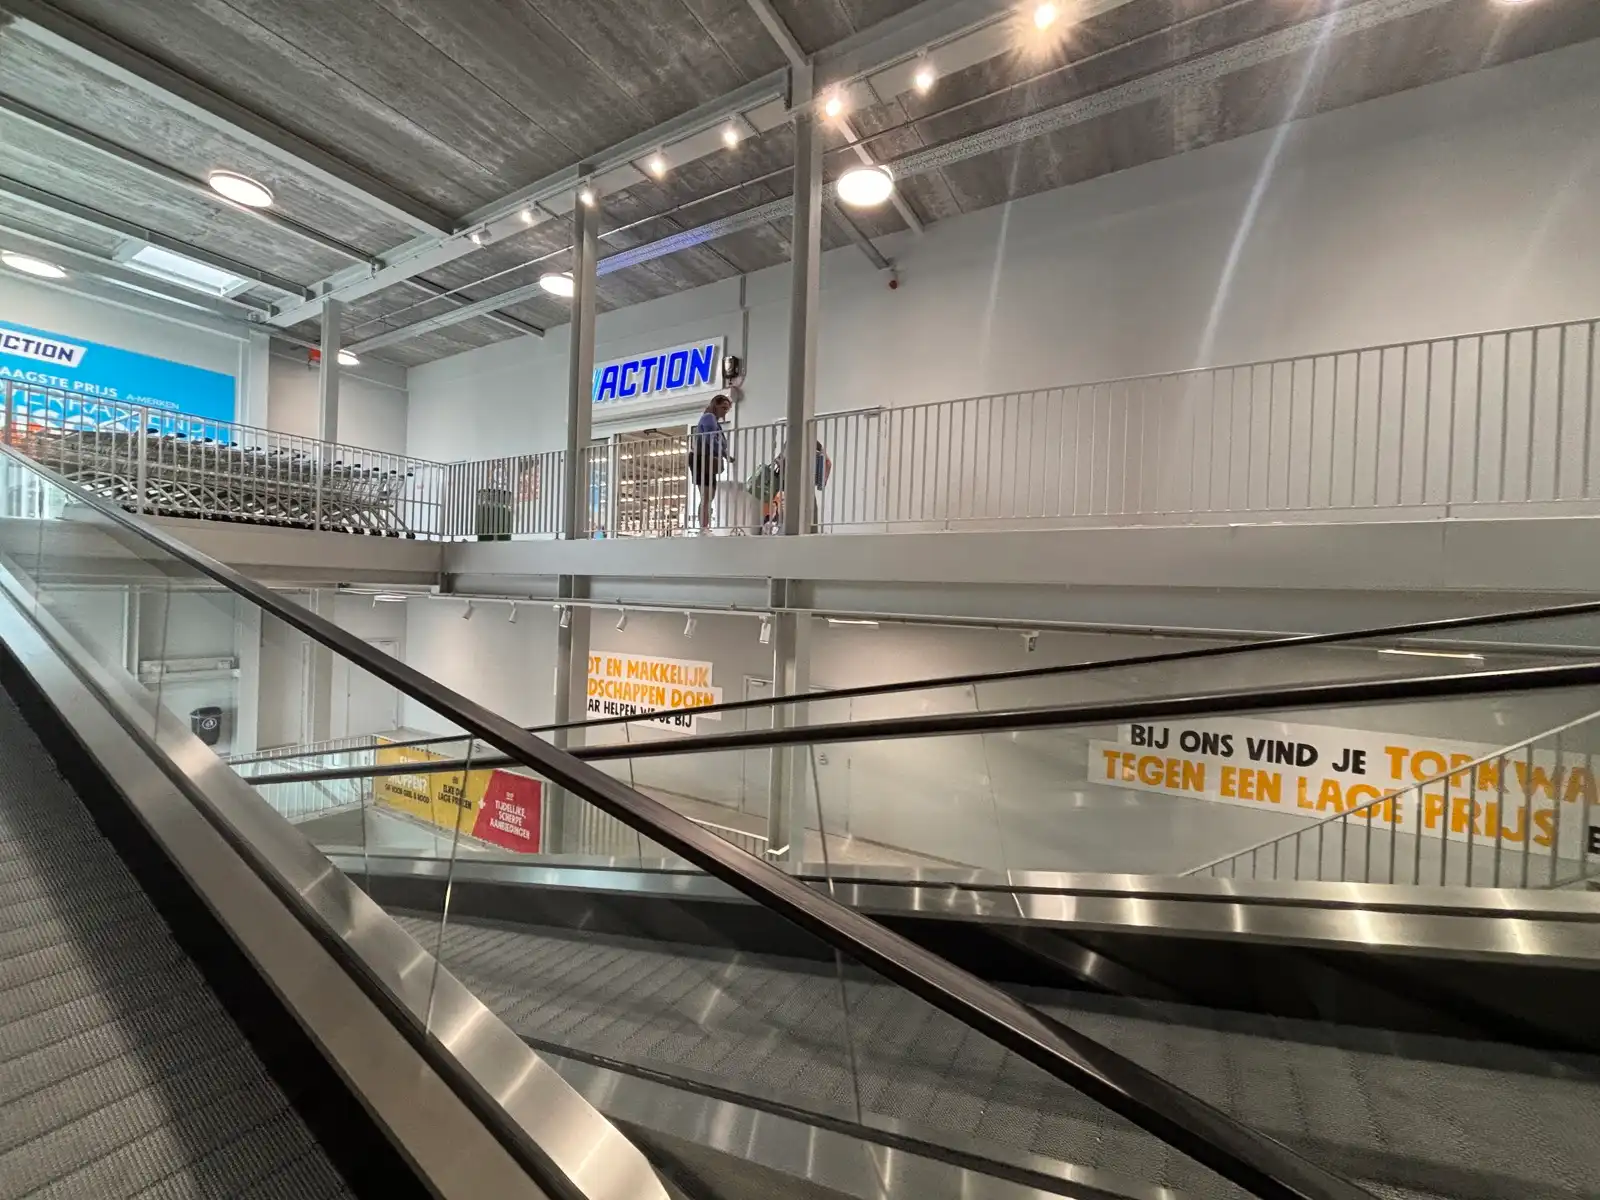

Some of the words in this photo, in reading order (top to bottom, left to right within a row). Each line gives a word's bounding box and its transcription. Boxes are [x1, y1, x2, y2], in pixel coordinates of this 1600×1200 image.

[0, 333, 74, 362] CTION
[597, 344, 714, 401] ACTION
[73, 380, 118, 398] PRIJS
[606, 658, 622, 677] EN
[627, 659, 710, 688] MAKKELIJK
[588, 678, 665, 707] DSCHAPPEN
[671, 689, 715, 709] DOEN
[588, 698, 601, 713] AR
[604, 700, 636, 717] HELPEN
[674, 714, 693, 729] BIJ
[1131, 724, 1170, 749] BIJ
[1179, 730, 1233, 757] ONS
[1246, 737, 1318, 767] VIND
[1332, 748, 1367, 775] JE
[1103, 749, 1205, 793] TEGEN
[1220, 765, 1282, 804] EEN
[1297, 776, 1403, 825] LAGE
[1423, 793, 1558, 848] PRIJS
